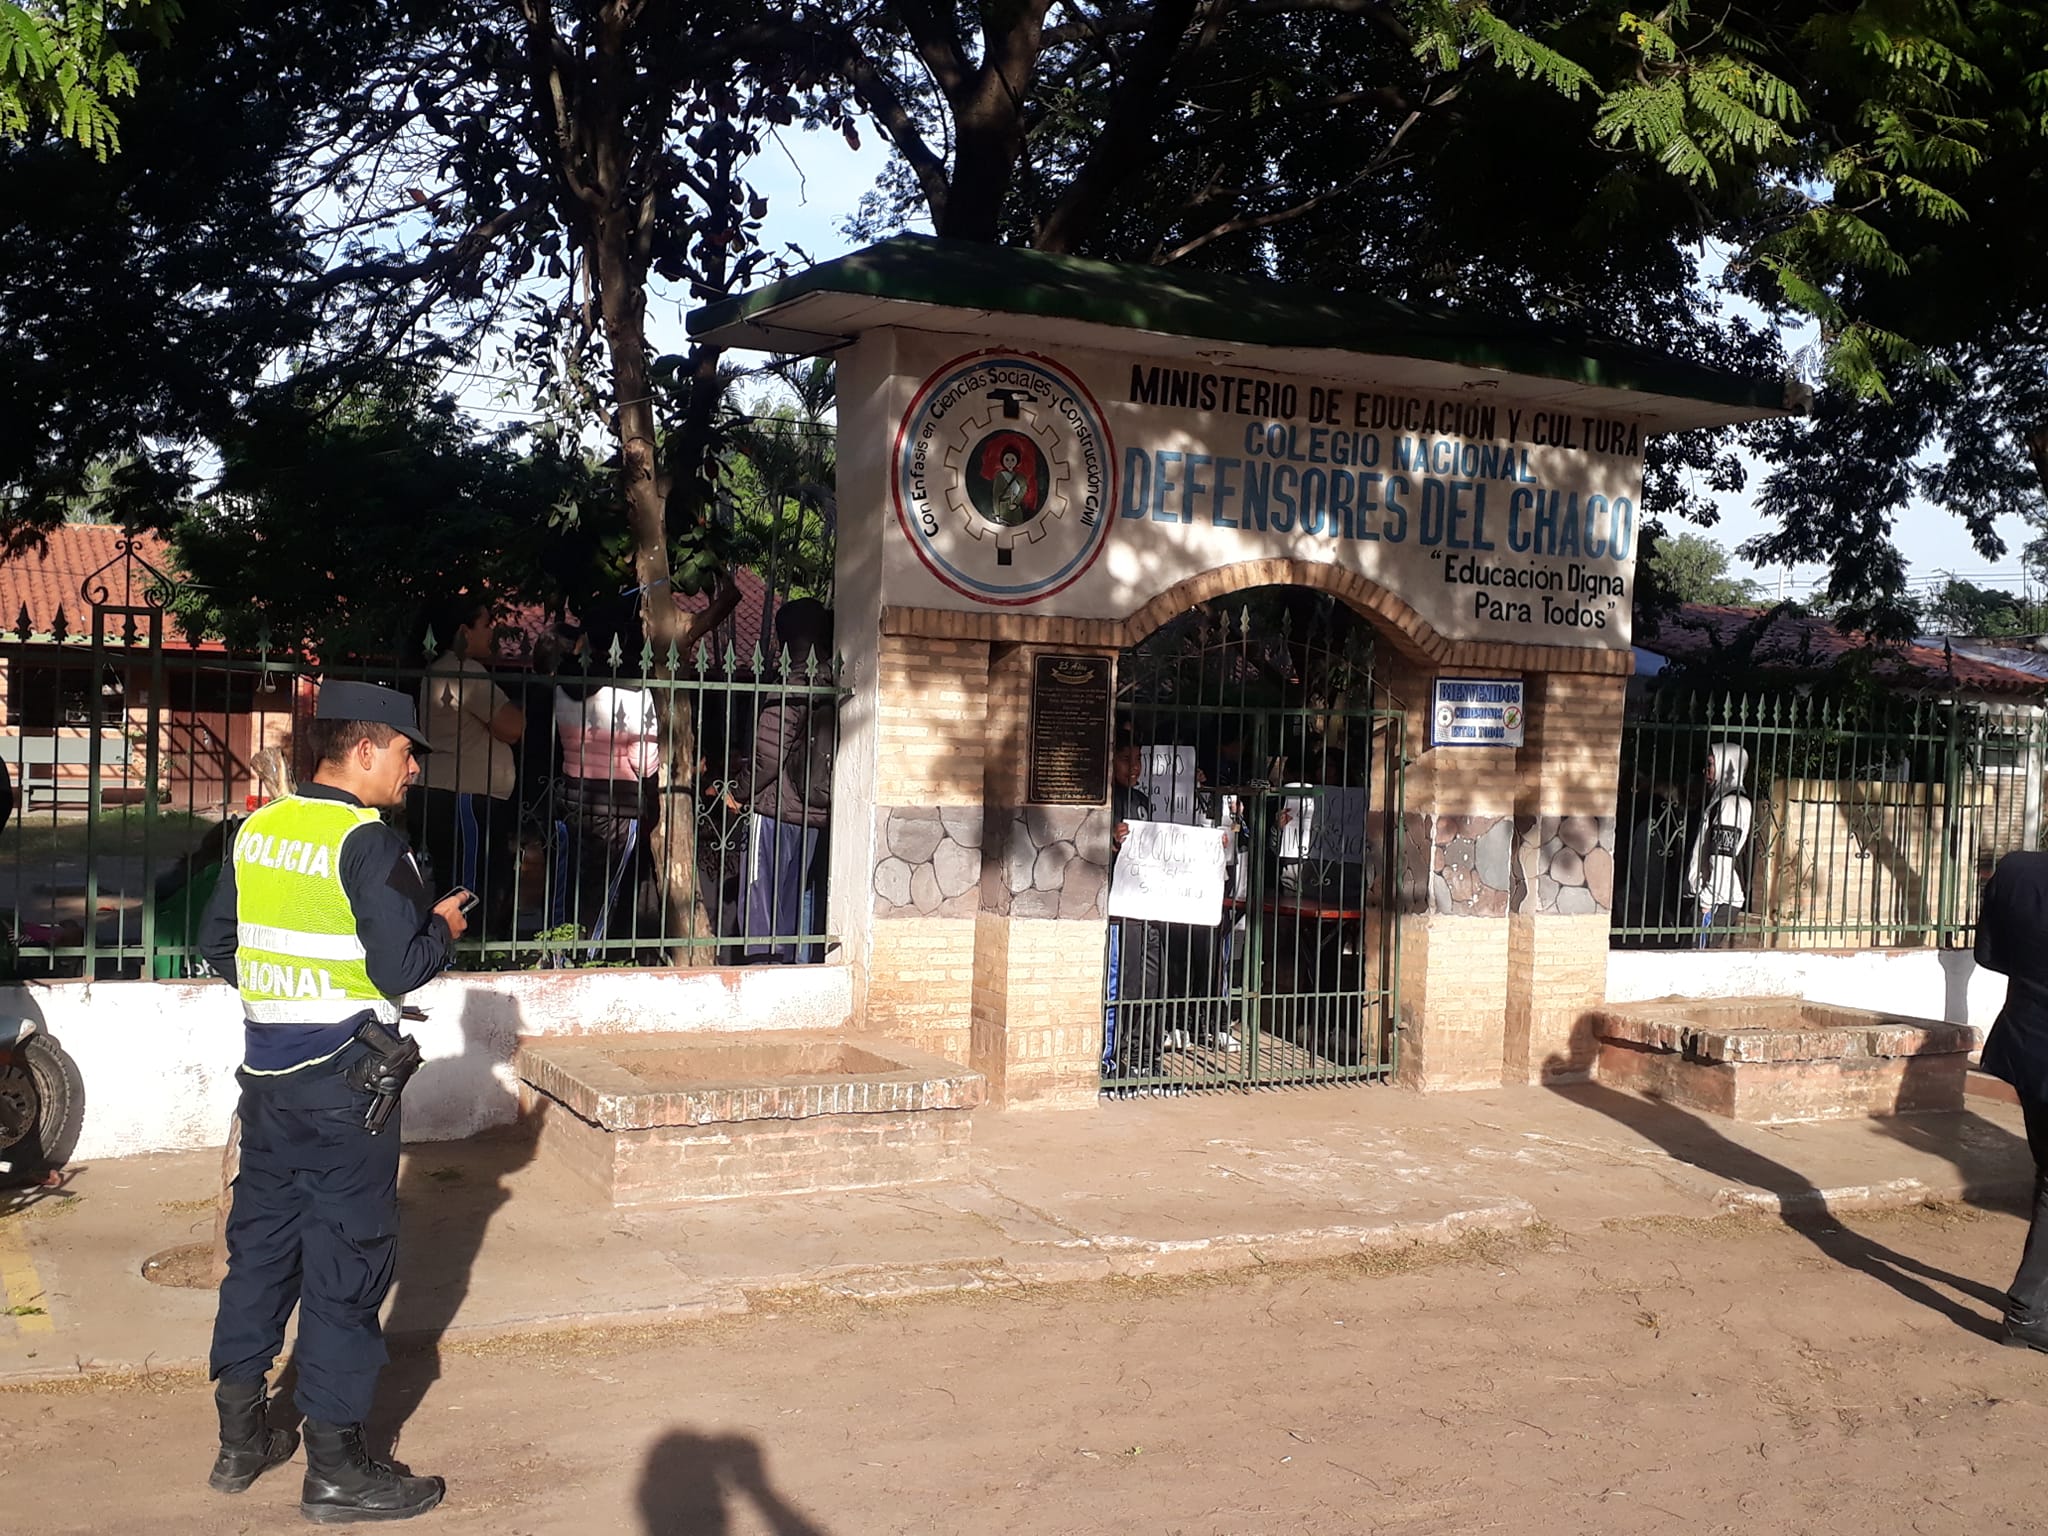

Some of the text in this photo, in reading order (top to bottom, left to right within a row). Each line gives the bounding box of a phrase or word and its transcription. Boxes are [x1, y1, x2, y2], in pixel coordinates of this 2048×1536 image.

[929, 373, 988, 420] Ciencias
[987, 367, 1053, 398] Sociales
[1047, 393, 1060, 409] y
[1129, 364, 1298, 420] MINISTERIO
[1308, 386, 1344, 426] DE
[1508, 408, 1522, 444] Y
[1532, 411, 1639, 457] CULTURA
[922, 421, 937, 440] en
[1244, 421, 1537, 484] COLEGIO NACIONAL
[910, 440, 929, 502] Enfasis
[919, 502, 940, 538] Con
[1080, 495, 1099, 528] Civil
[1120, 446, 1634, 562] DEFENSORES DEL CHACO
[1567, 563, 1625, 603] Digna
[1474, 590, 1532, 624] Para
[1439, 682, 1520, 703] BIENVENIDOS
